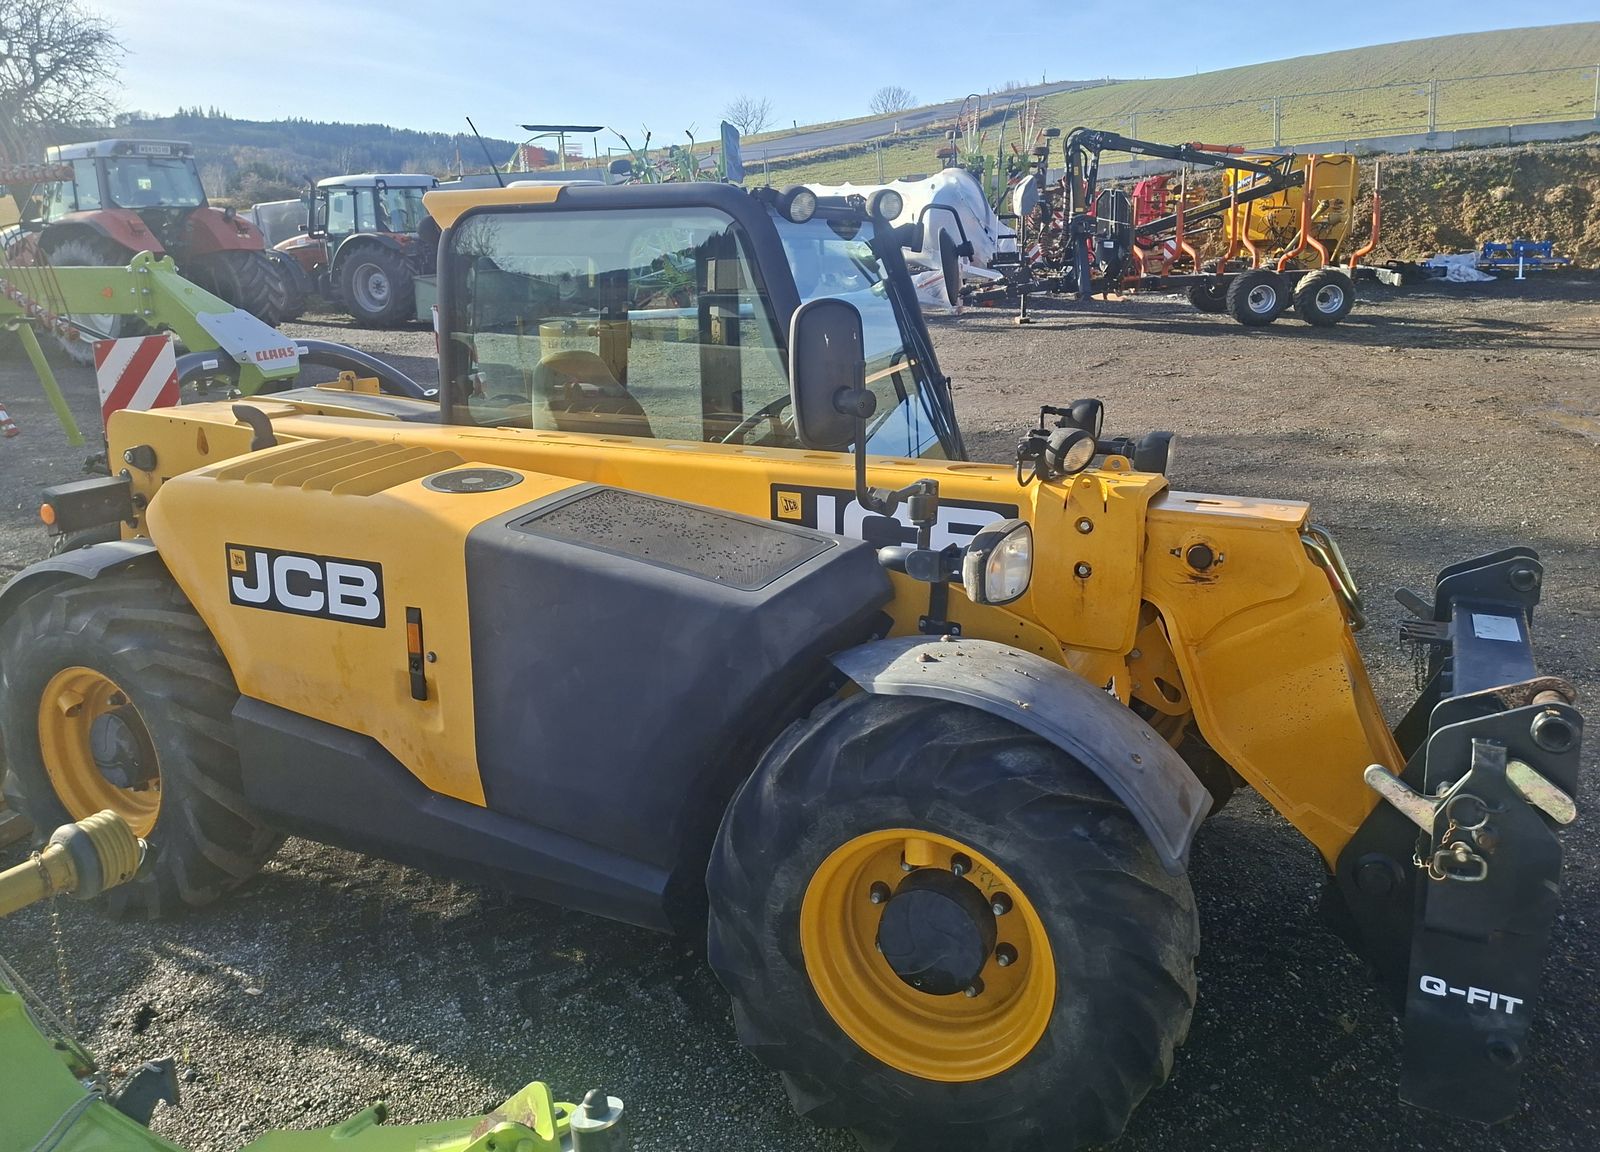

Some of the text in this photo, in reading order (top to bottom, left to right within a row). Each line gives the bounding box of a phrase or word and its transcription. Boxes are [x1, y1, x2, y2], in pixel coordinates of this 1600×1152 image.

[255, 346, 295, 362] CLAAS
[781, 498, 799, 511] JCB
[232, 551, 381, 620] JCB
[1419, 975, 1524, 1015] Q-FIT
